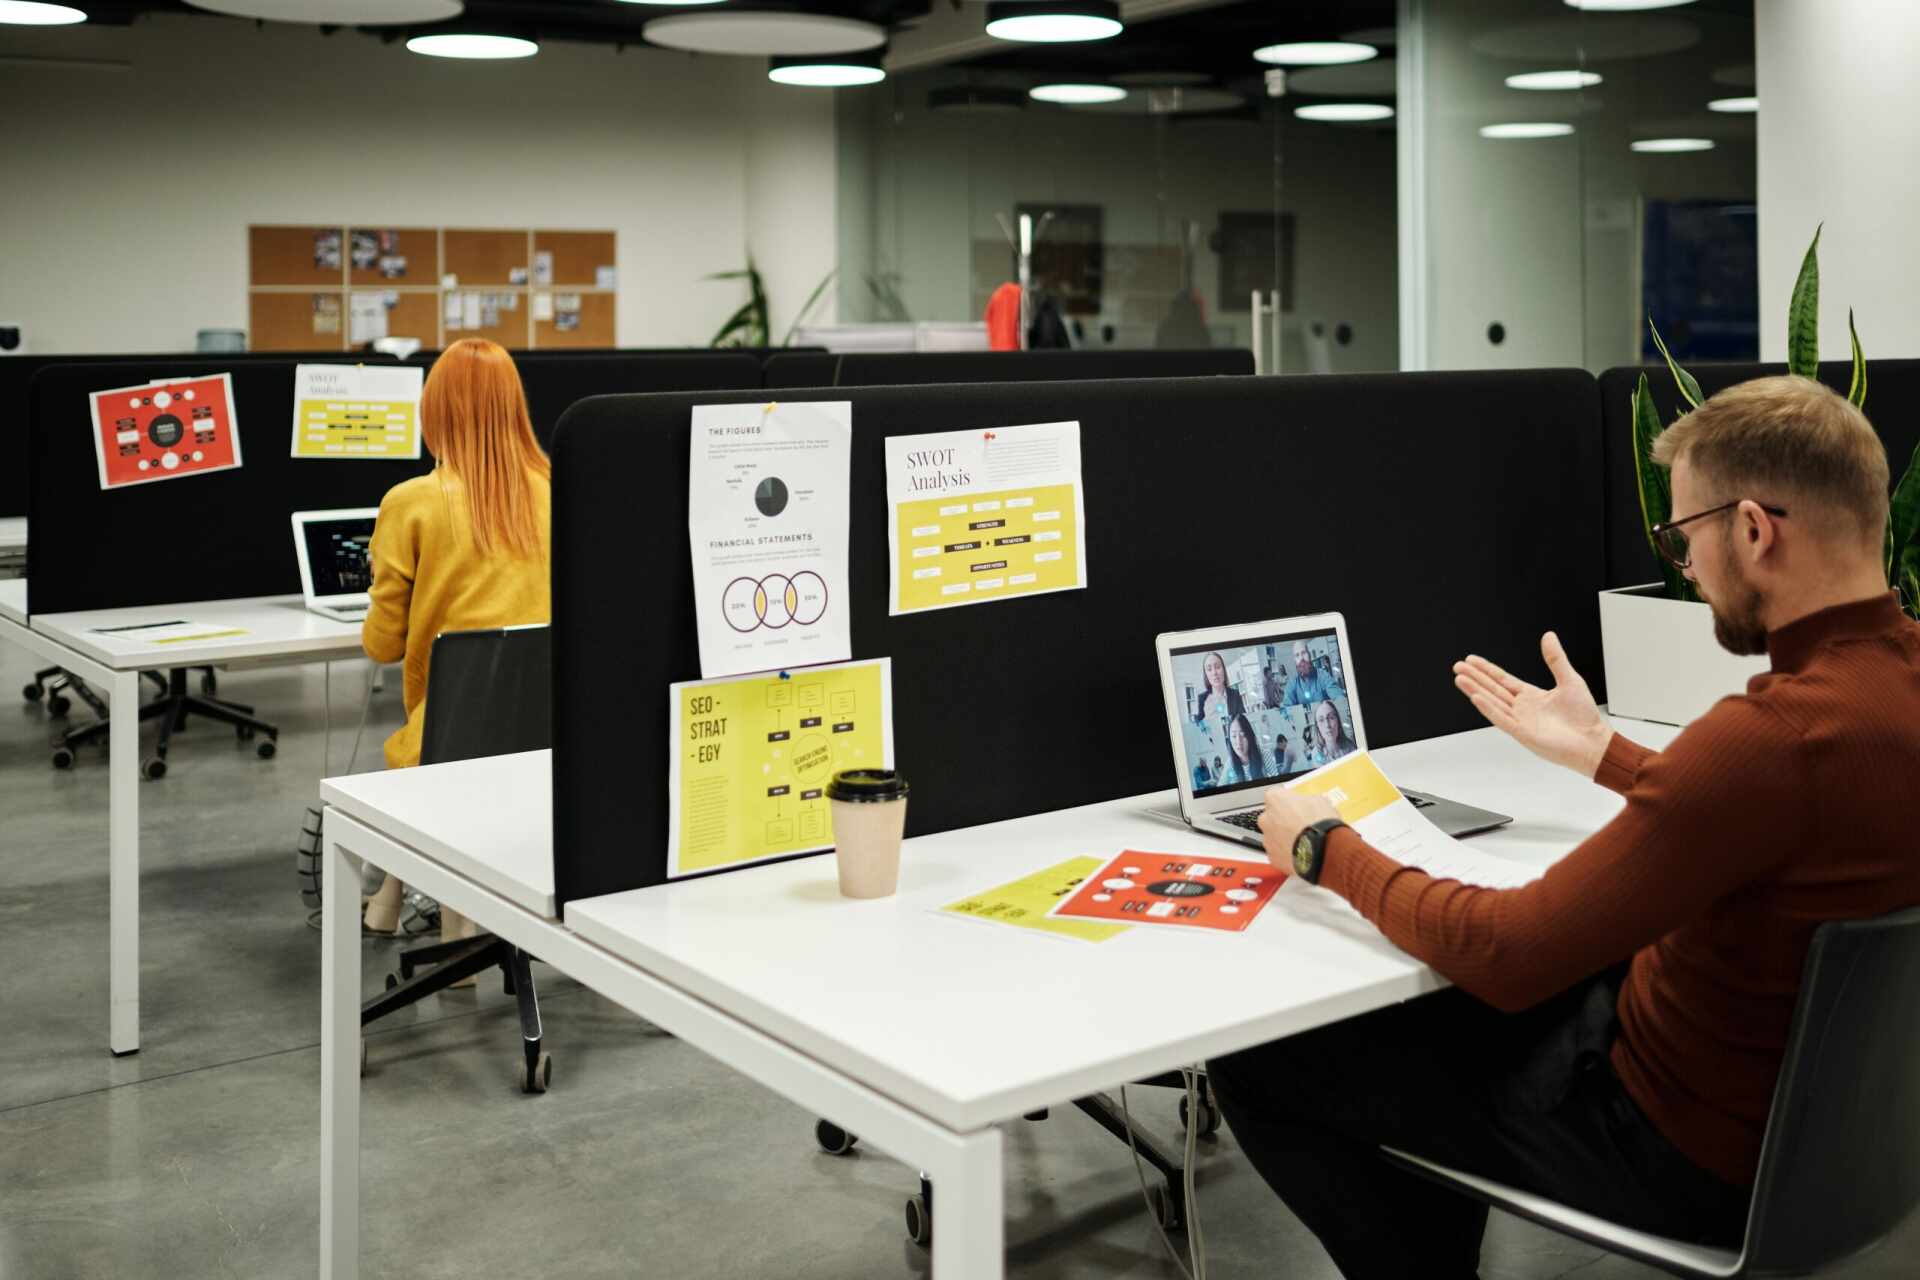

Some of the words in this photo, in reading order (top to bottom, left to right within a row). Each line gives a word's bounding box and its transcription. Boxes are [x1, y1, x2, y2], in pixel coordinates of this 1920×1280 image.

[708, 428, 724, 436] THE
[726, 426, 761, 435] FIGURES
[906, 447, 955, 469] SWOT
[907, 468, 971, 492] Analysis
[709, 538, 755, 549] FINANCIAL
[758, 533, 813, 545] STATEMENTS
[690, 695, 713, 715] SEO
[690, 717, 727, 740] STRAT
[699, 743, 721, 763] EGY
